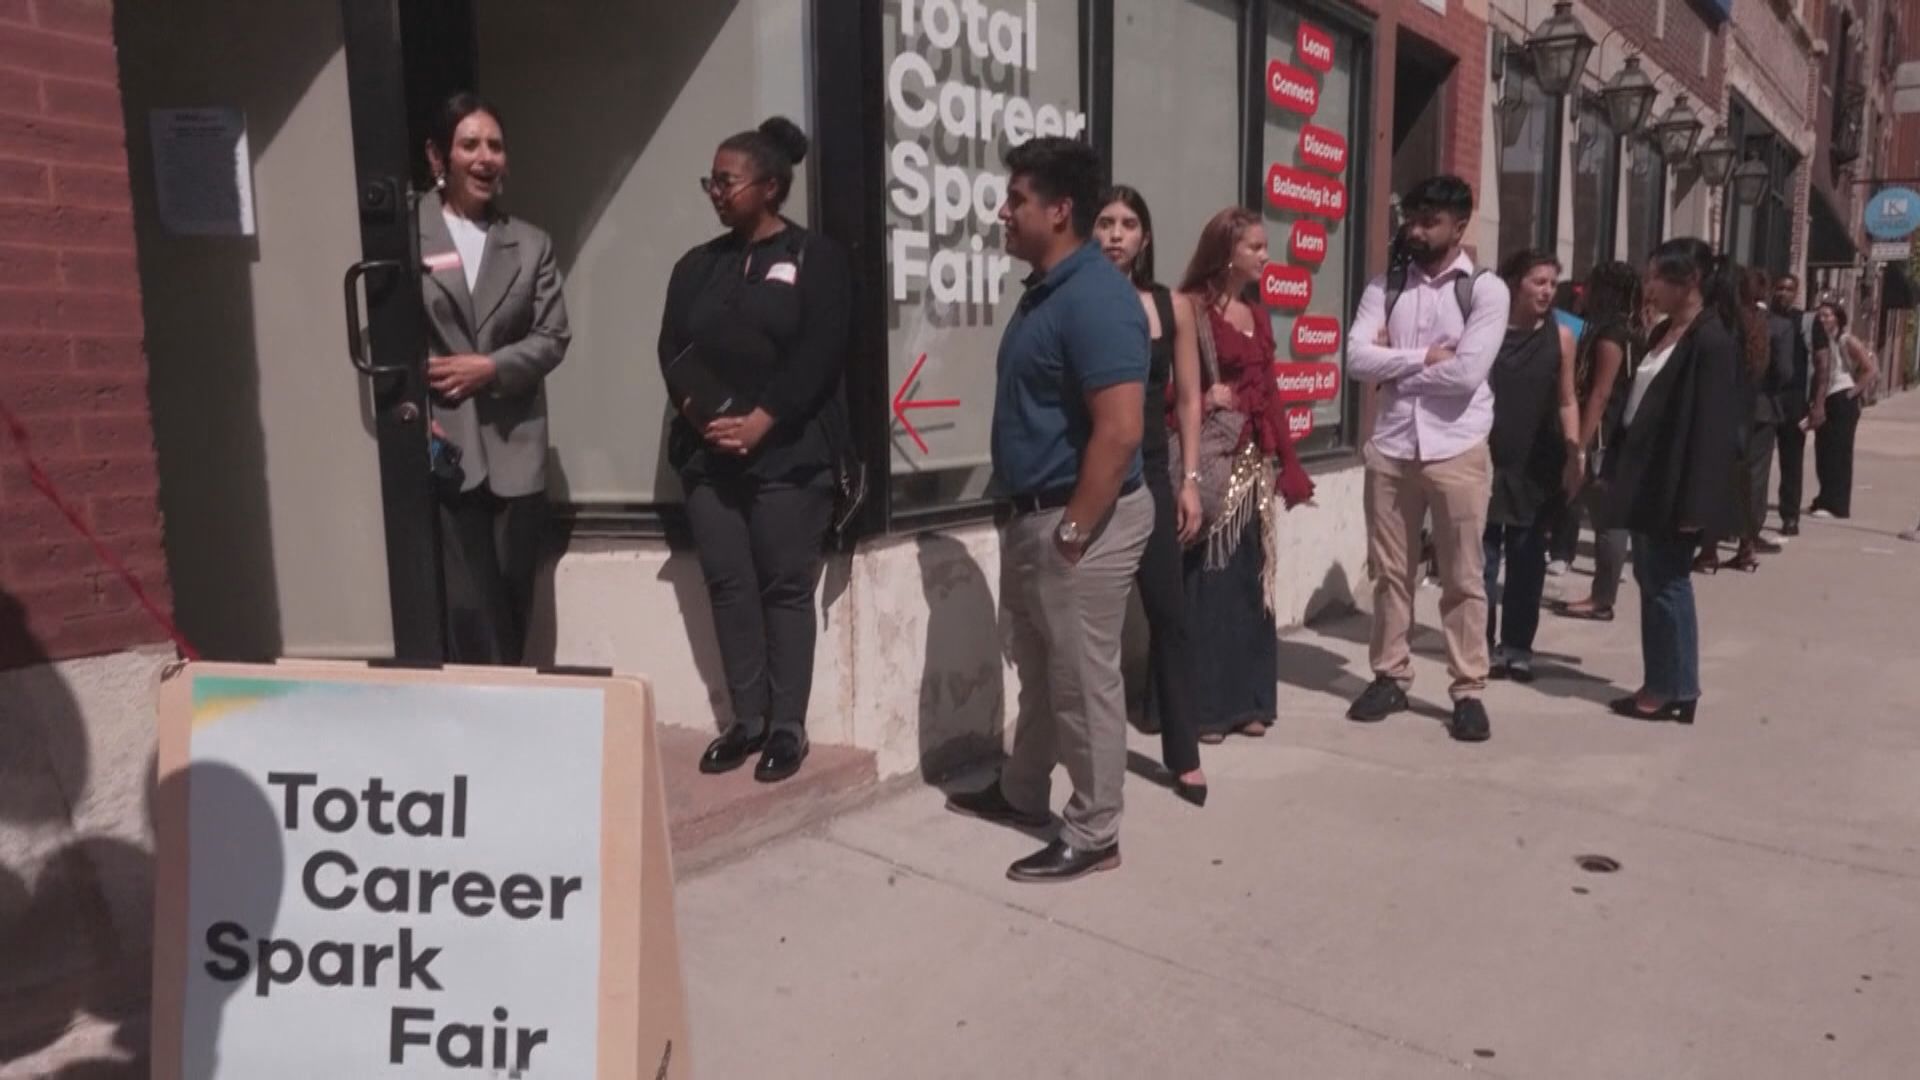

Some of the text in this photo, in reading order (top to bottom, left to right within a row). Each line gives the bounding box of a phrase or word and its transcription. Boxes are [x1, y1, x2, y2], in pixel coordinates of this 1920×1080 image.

[1302, 32, 1330, 62] Learn
[889, 51, 1086, 147] Career
[1272, 71, 1315, 105] Connect
[1304, 133, 1344, 162] Discover
[891, 140, 1008, 234] Spa
[1273, 174, 1342, 209] Balancing it all
[1296, 230, 1323, 252] Learn
[892, 228, 1011, 304] Fair
[1266, 274, 1308, 298] Connect
[1298, 325, 1337, 344] Discover
[1276, 371, 1336, 394] lancing it all
[268, 771, 467, 838] Total
[302, 849, 582, 920] Career
[204, 921, 444, 997] Spark
[390, 1006, 548, 1072] Fair
